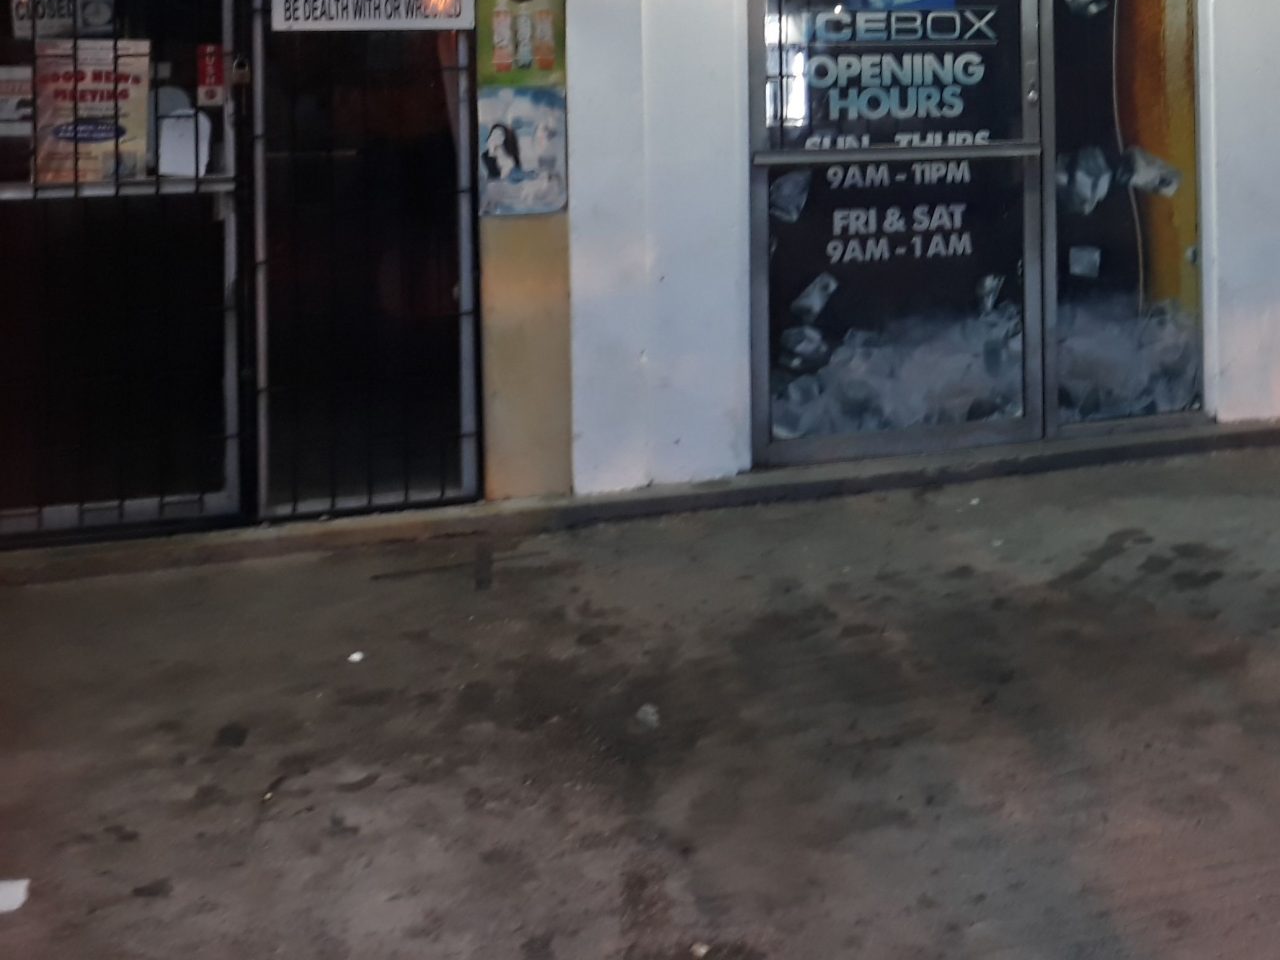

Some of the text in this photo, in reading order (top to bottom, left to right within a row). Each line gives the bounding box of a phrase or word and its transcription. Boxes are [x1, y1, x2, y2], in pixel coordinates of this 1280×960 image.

[807, 52, 986, 89] OPENING
[828, 85, 964, 121] HOURS
[826, 163, 891, 190] 9AM
[911, 160, 972, 186] 11PM
[832, 203, 967, 236] FRI & SAT
[825, 237, 891, 265] 9AM
